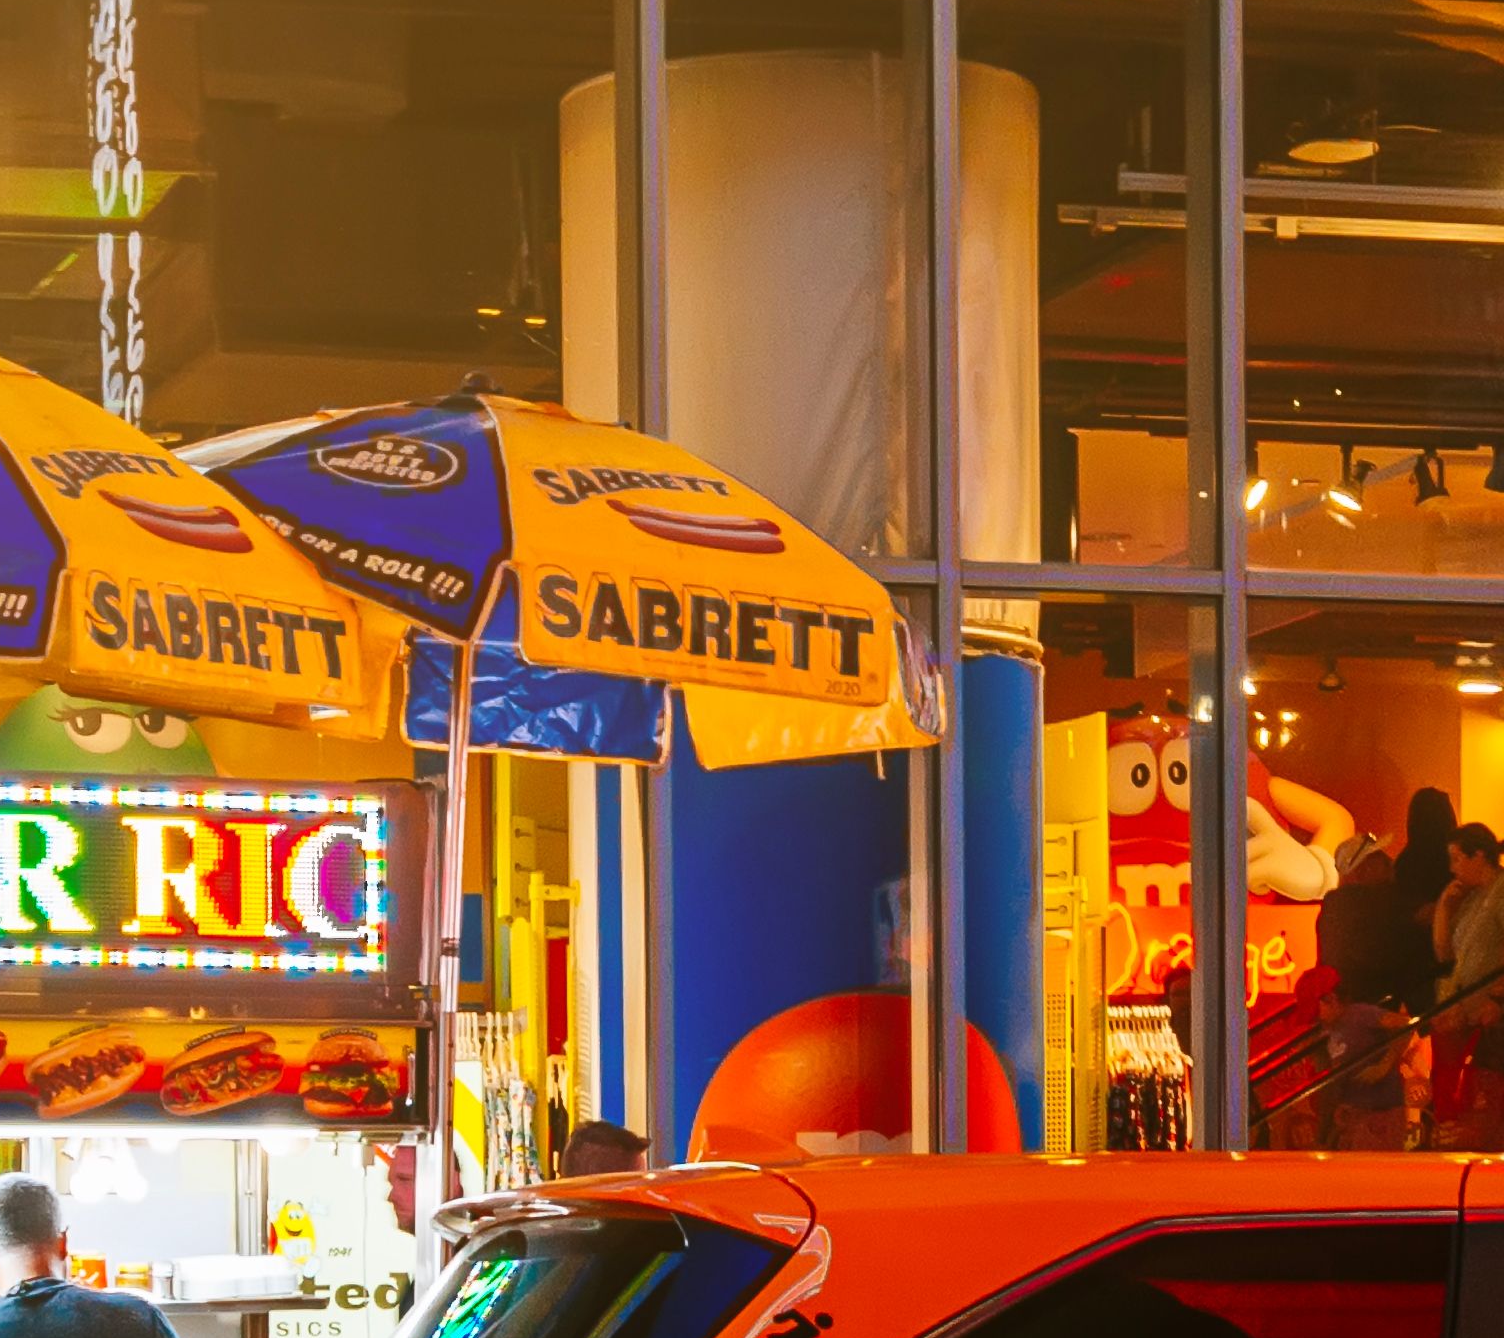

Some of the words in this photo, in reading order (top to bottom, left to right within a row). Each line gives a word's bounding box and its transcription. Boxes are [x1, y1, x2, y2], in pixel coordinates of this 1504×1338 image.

[30, 450, 183, 500] SABRETT
[532, 466, 730, 506] SABRETT
[299, 533, 337, 554] ON
[339, 548, 359, 563] A
[364, 554, 426, 583] ROLL
[86, 573, 346, 679] SABRETT
[534, 567, 874, 677] SABRETT
